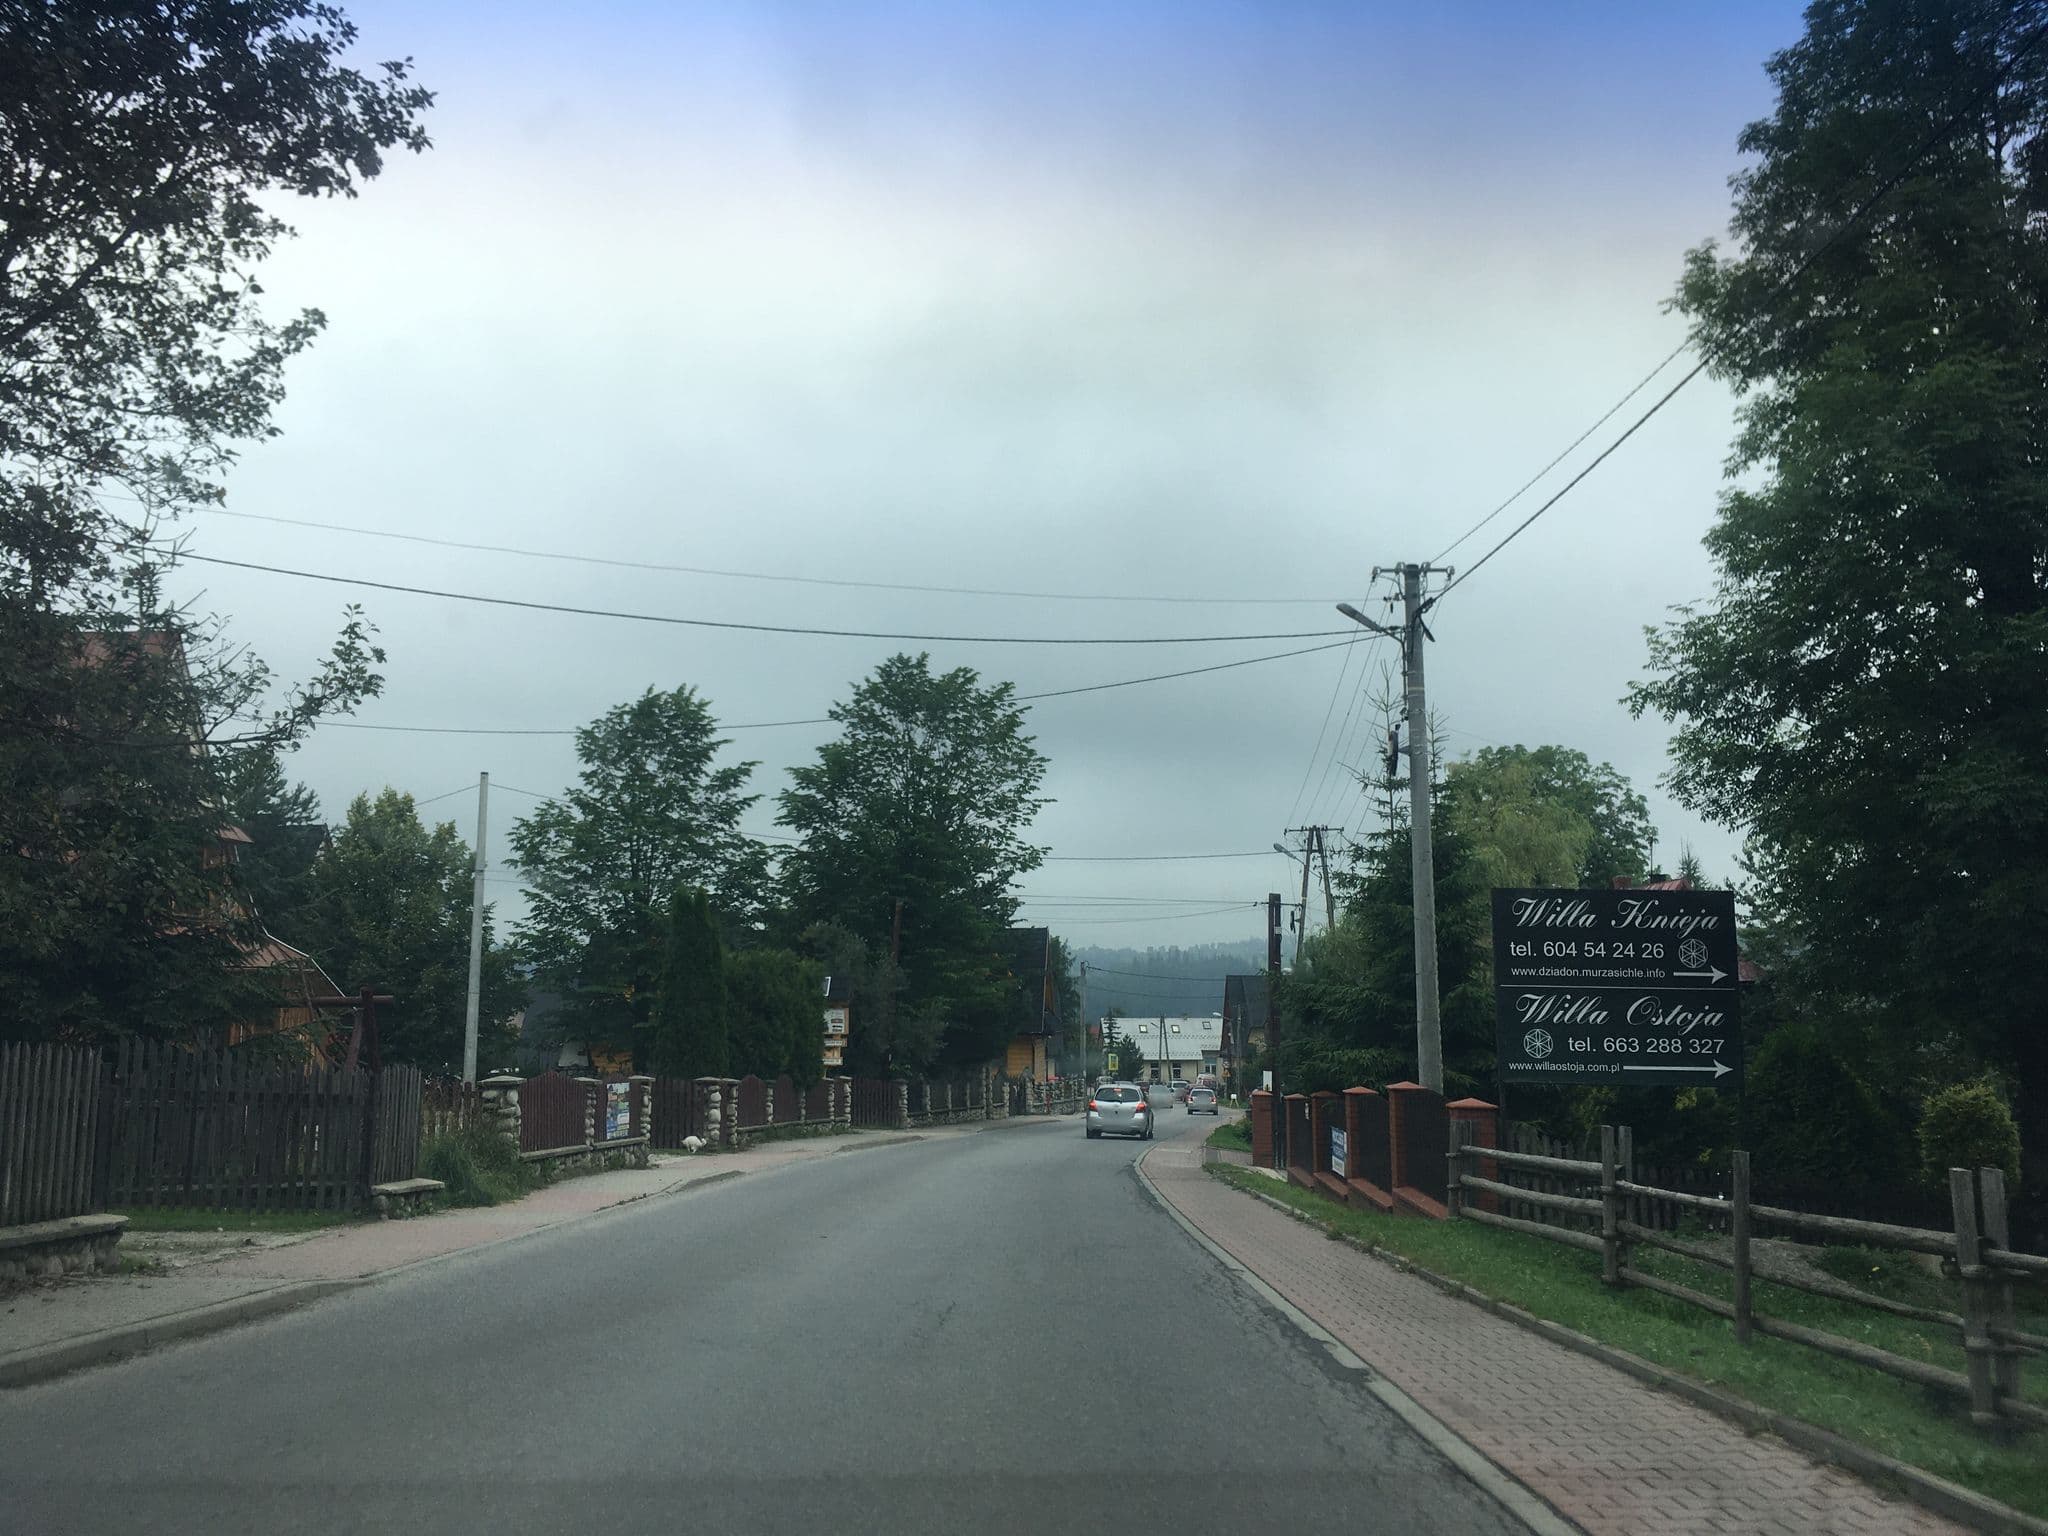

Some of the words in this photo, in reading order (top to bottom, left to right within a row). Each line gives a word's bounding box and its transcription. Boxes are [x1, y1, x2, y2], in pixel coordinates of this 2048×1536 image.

[1512, 898, 1597, 928] Willa
[1611, 899, 1719, 939] Knieja
[1510, 941, 1537, 957] tel.
[1543, 941, 1577, 957] 604
[1584, 942, 1606, 958] 54
[1612, 942, 1635, 958] 24
[1641, 943, 1664, 959] 26
[1511, 966, 1666, 978] www.dziadon.murzasichle.info
[1516, 993, 1609, 1025] Willa
[1626, 995, 1724, 1036] Ostoja
[1568, 1037, 1597, 1052] tel.
[1603, 1037, 1640, 1053] 663
[1646, 1038, 1682, 1053] 288
[1689, 1038, 1725, 1054] 327
[1508, 1061, 1620, 1074] www.willaostoja.com.pl
